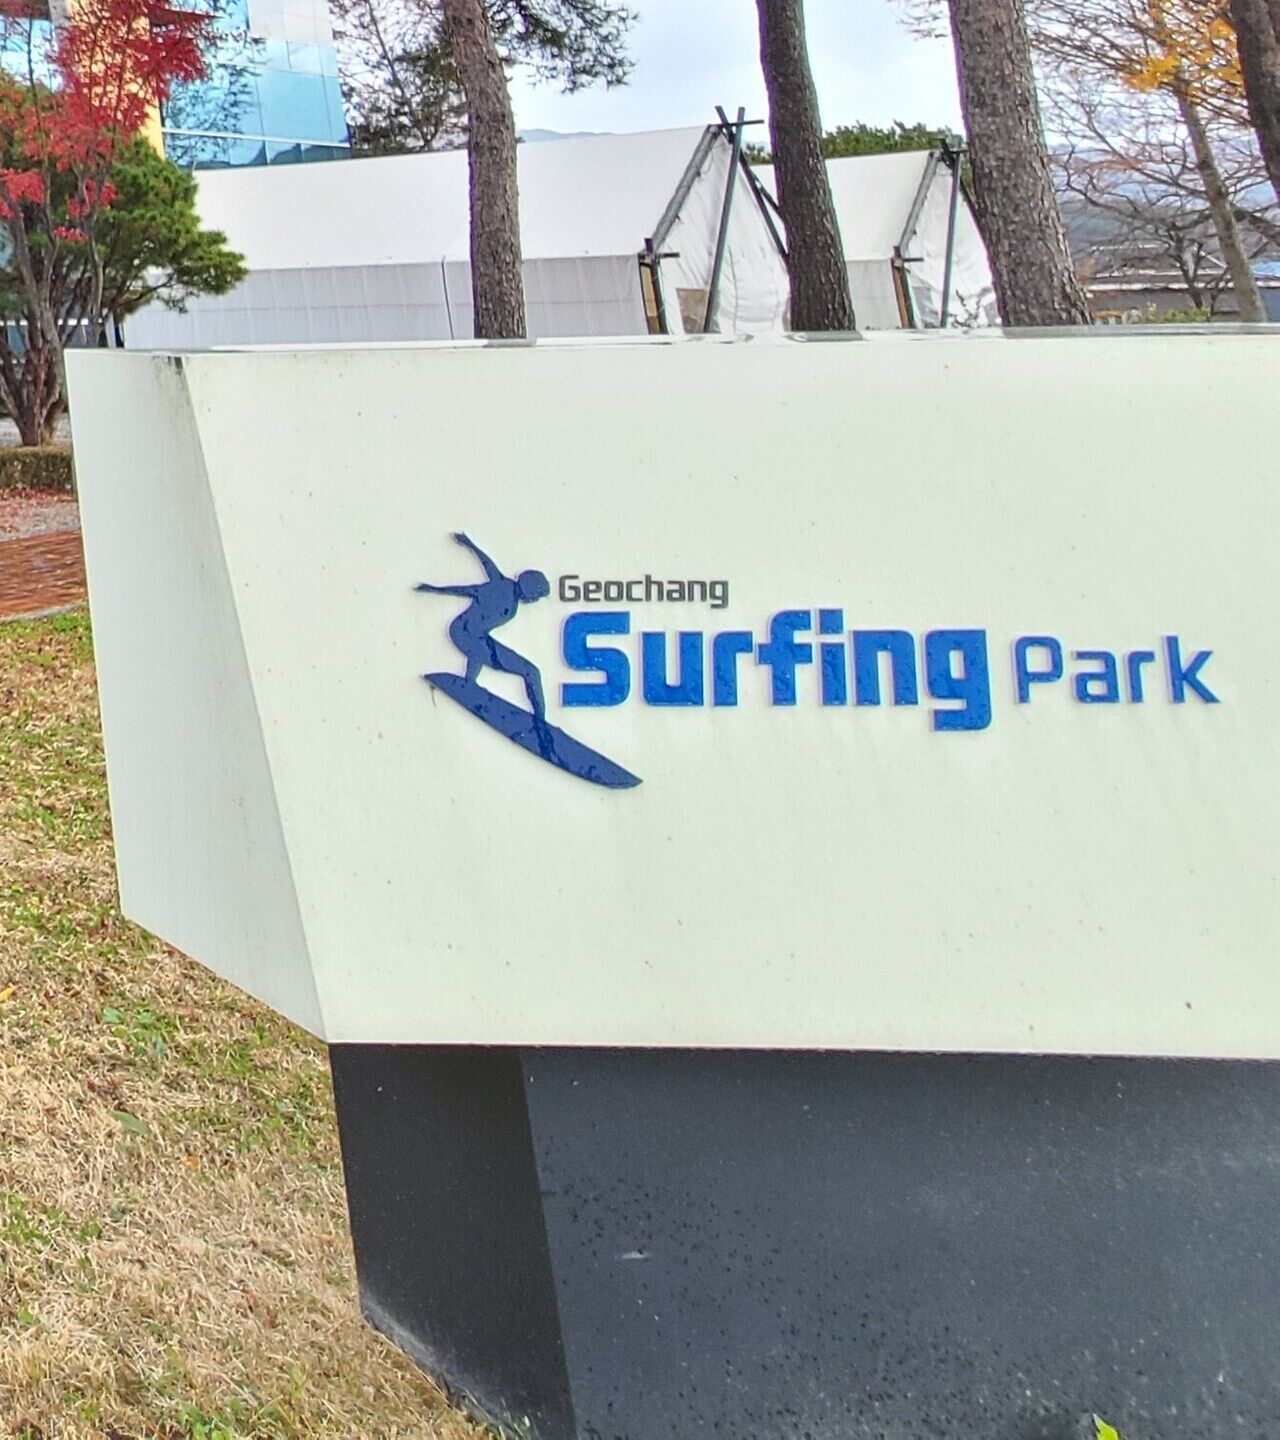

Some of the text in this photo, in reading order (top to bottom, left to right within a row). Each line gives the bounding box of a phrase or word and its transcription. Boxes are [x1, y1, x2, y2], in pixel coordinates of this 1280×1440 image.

[559, 574, 729, 609] Geochang
[561, 608, 1221, 731] Surfing Park
